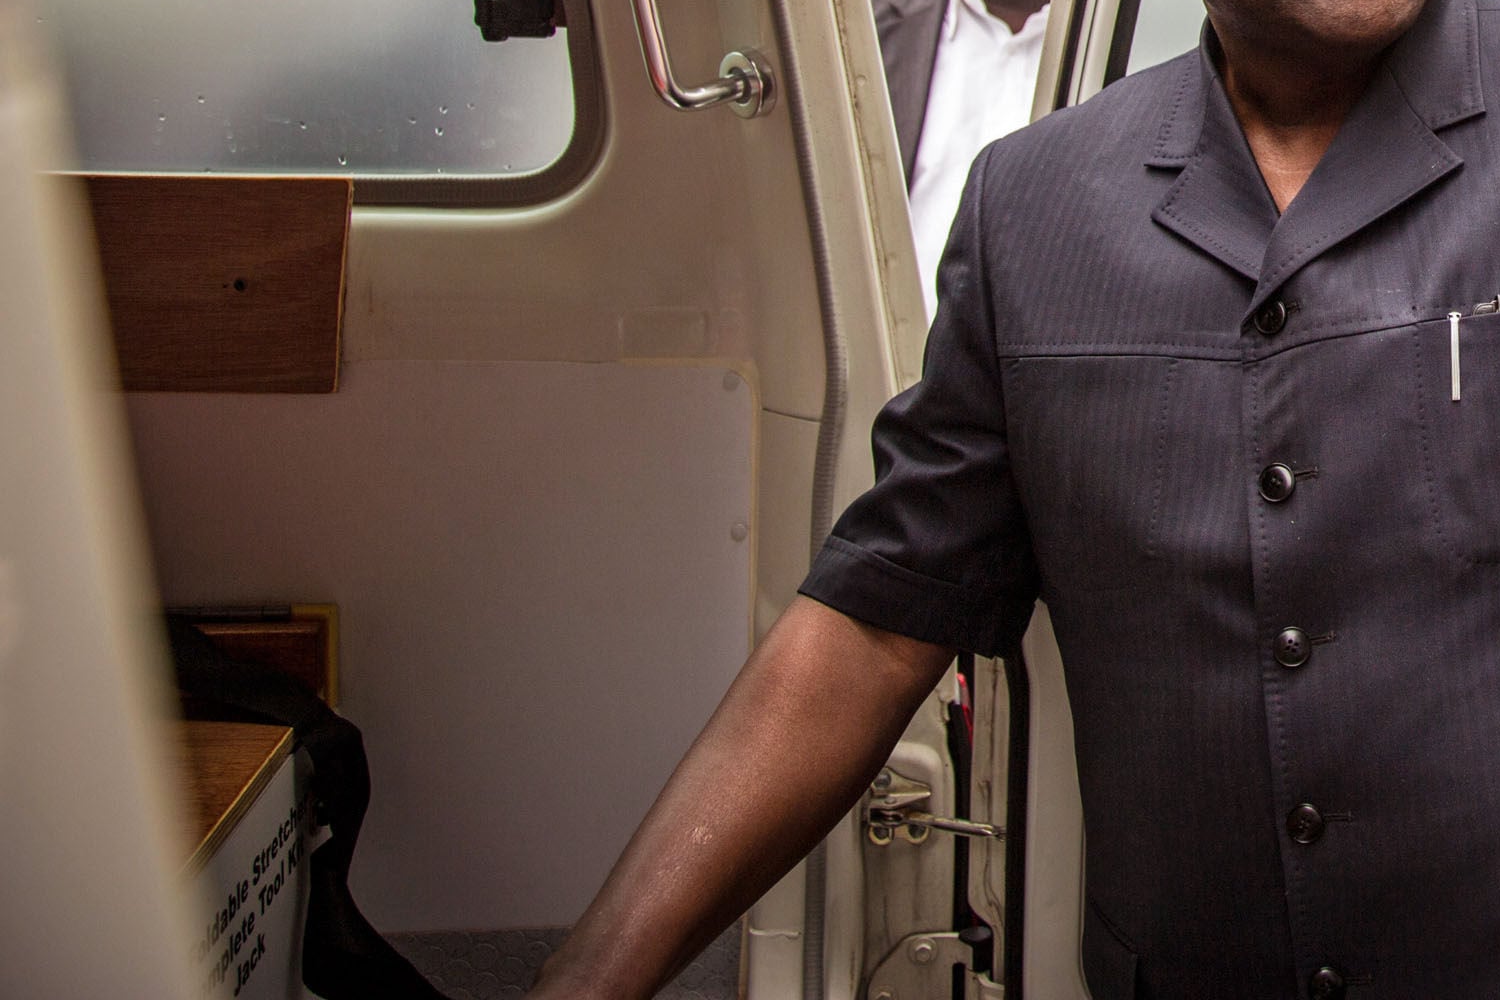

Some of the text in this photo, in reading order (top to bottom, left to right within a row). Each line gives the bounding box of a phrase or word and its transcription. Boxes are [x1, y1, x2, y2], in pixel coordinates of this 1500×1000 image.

[203, 832, 304, 994] mplete Tool Kit
[234, 933, 265, 997] Jack
